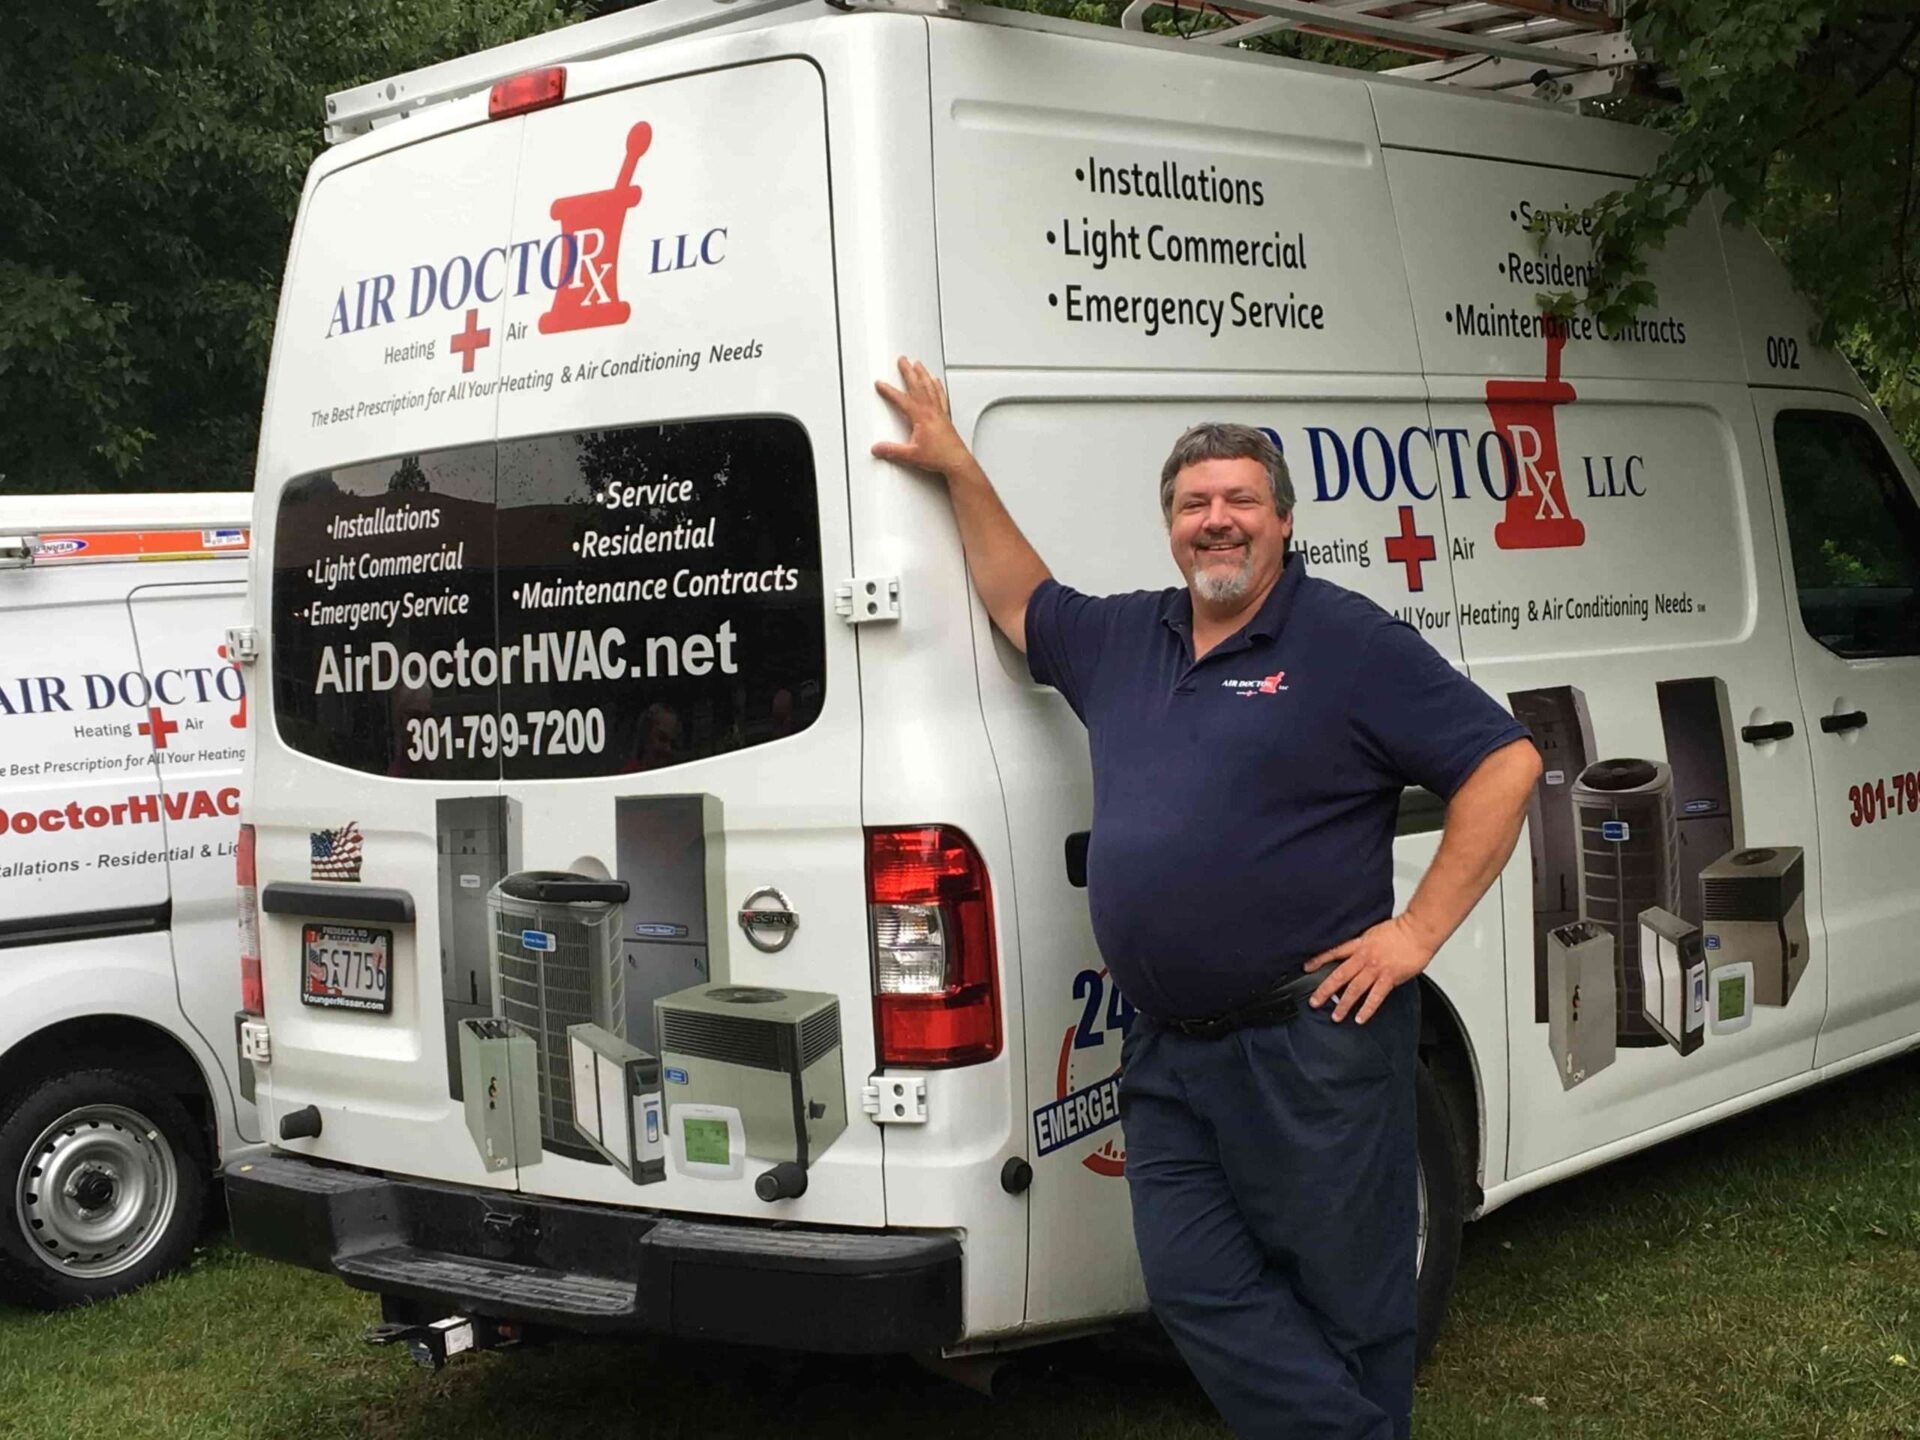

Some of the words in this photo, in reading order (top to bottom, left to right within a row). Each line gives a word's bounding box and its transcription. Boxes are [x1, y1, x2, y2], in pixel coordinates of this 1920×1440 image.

[1089, 156, 1265, 206] Installations
[1063, 217, 1142, 270] Light
[1147, 224, 1307, 269] Commercial
[325, 273, 396, 338] AIR
[648, 227, 728, 274] LLC
[1065, 284, 1225, 337] Emergency
[1230, 291, 1325, 330] Service
[1455, 303, 1592, 341] Maintenance
[1596, 312, 1687, 344] Cntracts
[383, 339, 436, 366] Heating
[506, 320, 529, 342] Air
[1766, 335, 1800, 370] 002
[311, 409, 328, 428] The
[330, 404, 355, 426] Best
[356, 388, 425, 422] Prescription
[426, 385, 446, 412] for
[447, 381, 466, 402] All
[467, 377, 498, 399] Your
[498, 369, 554, 395] Heating
[560, 365, 573, 384] &
[575, 360, 599, 382] Air
[600, 346, 701, 379] Conditioning
[708, 339, 763, 364] Needs
[606, 475, 694, 510] Service
[1582, 455, 1648, 498] LLC
[332, 504, 441, 541] Installations
[580, 518, 716, 559] Residential
[315, 556, 357, 589] Light
[358, 541, 464, 579] Commercial
[1294, 538, 1371, 567] Heating
[1452, 536, 1476, 561] Air
[520, 576, 667, 610] Maintenance
[672, 563, 799, 600] Contracts
[310, 599, 399, 632] Emergency
[401, 589, 470, 617] Service
[1415, 607, 1451, 630] Your
[1460, 597, 1520, 631] Heating
[1527, 606, 1539, 622] &
[1543, 603, 1564, 621] Air
[1566, 593, 1649, 622] Conditioning
[1655, 592, 1693, 615] Needs
[315, 619, 738, 694] AirDoctorHVAC.net
[74, 722, 132, 739] Heating
[184, 717, 205, 731] Air
[405, 707, 606, 763] 301-799-7200
[10, 762, 41, 777] Best
[44, 754, 123, 774] Prescription
[124, 753, 145, 771] for
[147, 751, 165, 766] All
[167, 750, 196, 764] Your
[198, 747, 246, 762] Heating
[1848, 770, 1920, 828] 301-79
[0, 858, 80, 878] allations
[97, 845, 195, 869] Residential
[200, 843, 212, 858] &
[742, 910, 792, 926] NISSAN
[303, 993, 385, 1011] YoungerNissan.com
